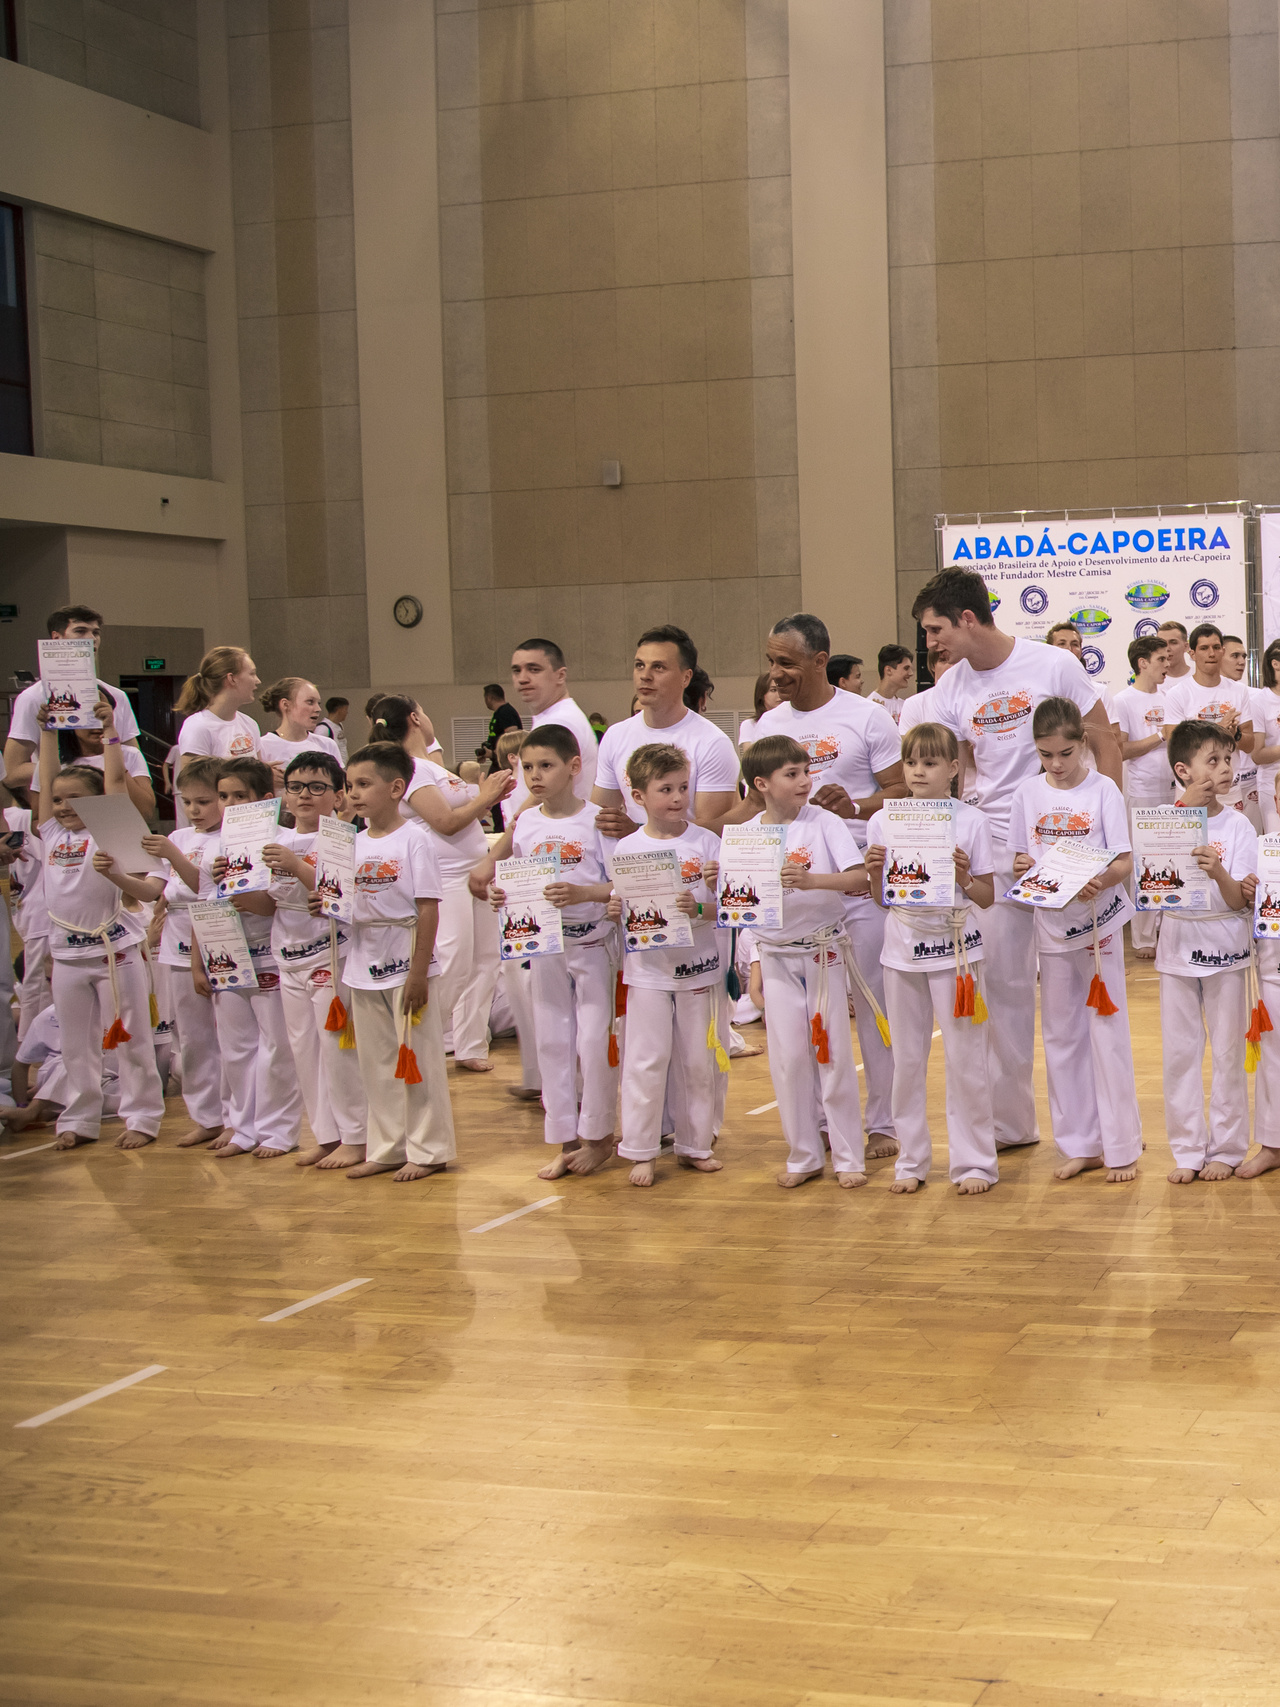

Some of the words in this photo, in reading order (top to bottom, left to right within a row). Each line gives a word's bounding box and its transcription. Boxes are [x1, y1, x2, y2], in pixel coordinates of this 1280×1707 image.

[953, 526, 1230, 560] ABADÁ-CAPOEIRA
[956, 561, 996, 572] sociação
[998, 560, 1040, 570] Brasileira
[1040, 559, 1049, 568] de
[1051, 557, 1076, 568] Apoio
[1085, 555, 1158, 566] Desenvolvimento
[1160, 554, 1170, 562] da
[1172, 552, 1231, 563] Arte-Capoeira
[1000, 571, 1044, 580] Fundador:
[1047, 570, 1077, 578] Mestre
[1079, 568, 1112, 576] Camisa
[975, 710, 1029, 724] ABADÁ-CAPOEIRA
[888, 813, 952, 821] CERTIFICADO
[1137, 821, 1202, 829] CERTIFICADO
[1056, 846, 1109, 862] CERTIFICADO
[500, 867, 555, 880] CERTIFICADO
[615, 863, 674, 875] CERTIFICADO
